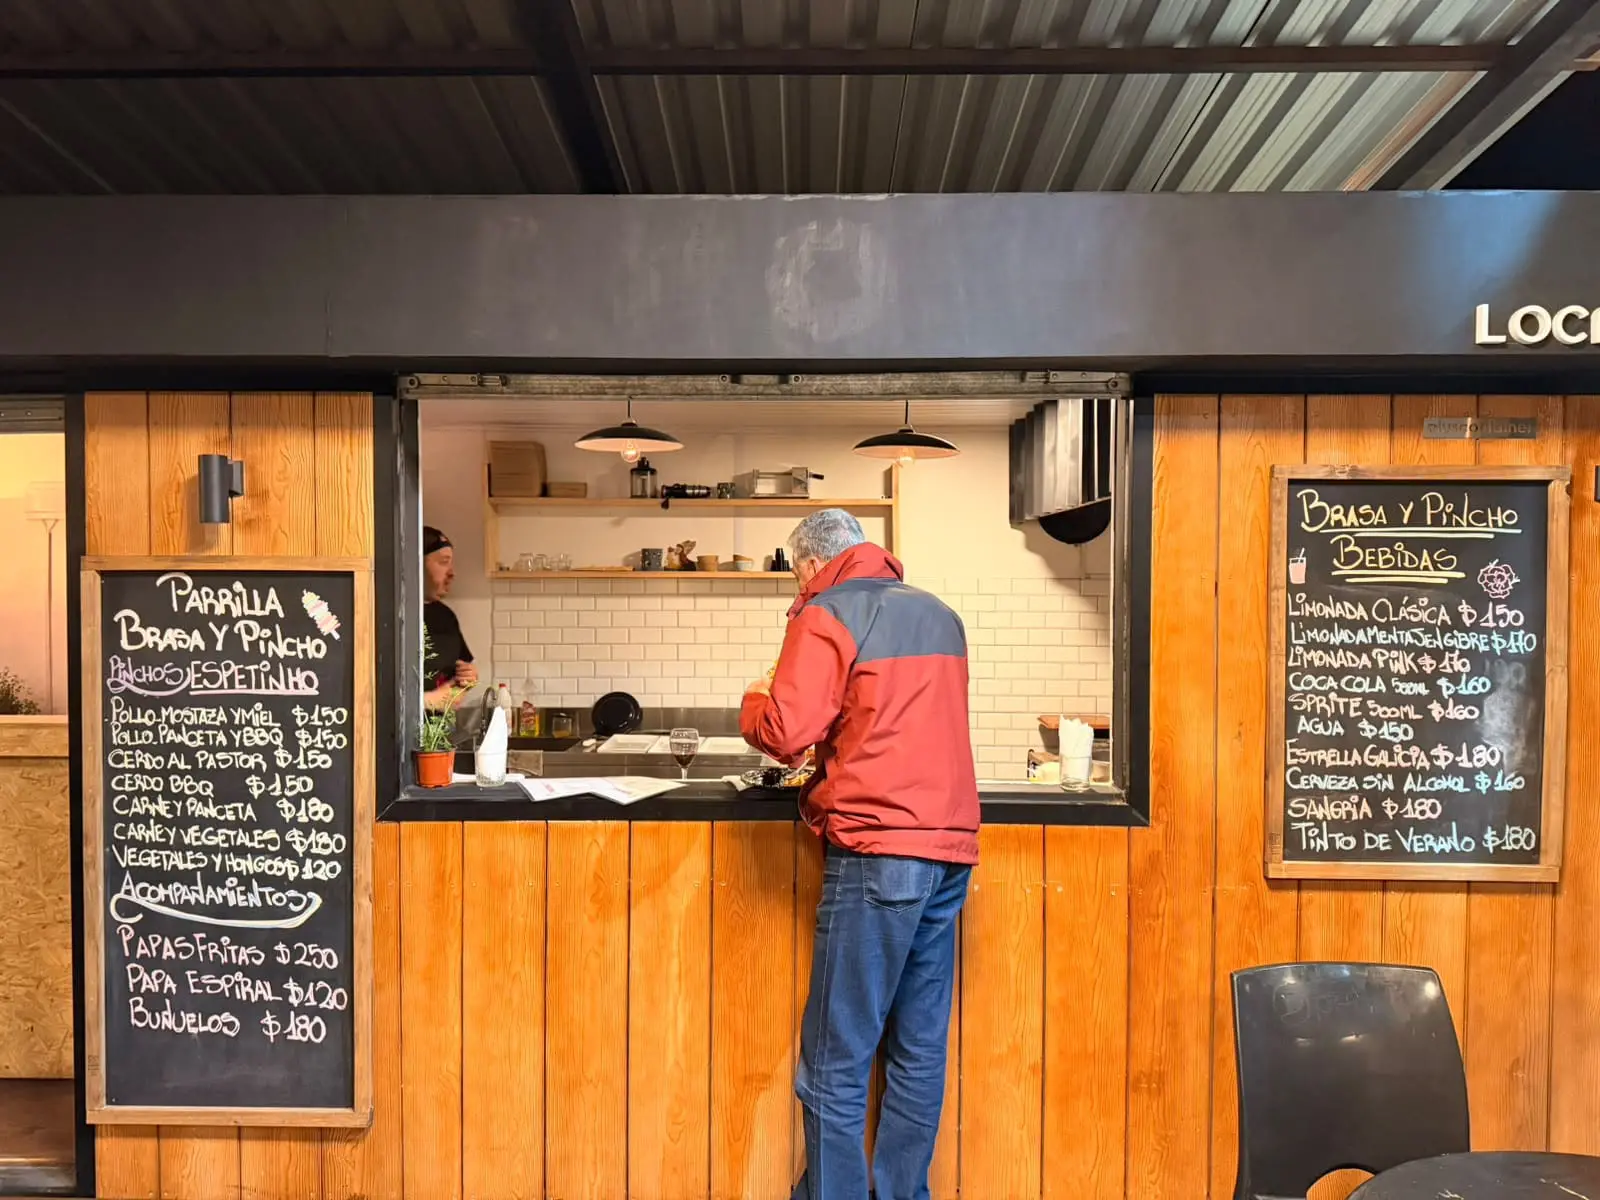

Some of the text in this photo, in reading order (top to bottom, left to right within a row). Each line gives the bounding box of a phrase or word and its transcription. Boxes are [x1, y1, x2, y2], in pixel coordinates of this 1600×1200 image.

[1297, 489, 1518, 532] BRASA Y PINCHO
[1330, 534, 1457, 571] BEBIDAS
[156, 572, 284, 618] PARRILLA
[1287, 593, 1369, 620] LIMONADA
[113, 609, 327, 659] BRASA Y PINCHO
[1287, 645, 1372, 669] LIMONADA
[1289, 672, 1338, 691] COCA
[1340, 675, 1387, 693] COLA
[292, 704, 348, 727] $150
[1288, 691, 1362, 718] SPRITE
[295, 728, 347, 750] $150
[1297, 715, 1344, 736] AGUA
[108, 748, 164, 770] CERDO
[167, 753, 192, 770] AL
[196, 752, 267, 773] PASTOR
[1286, 738, 1362, 768] ESTRELLA
[111, 775, 164, 794] CERDO
[169, 776, 214, 797] BBQ
[1285, 766, 1359, 790] CERVEZA
[186, 797, 257, 821] PANCETA
[180, 825, 281, 851] VEGETALES
[285, 828, 347, 857] $180
[1362, 829, 1392, 851] DE
[1394, 821, 1475, 854] VERANO
[1482, 824, 1536, 854] $180
[111, 844, 208, 872] VEGETALES
[211, 852, 222, 872] Y
[126, 963, 177, 995] PAPA
[185, 970, 283, 1003] ESPIRAL
